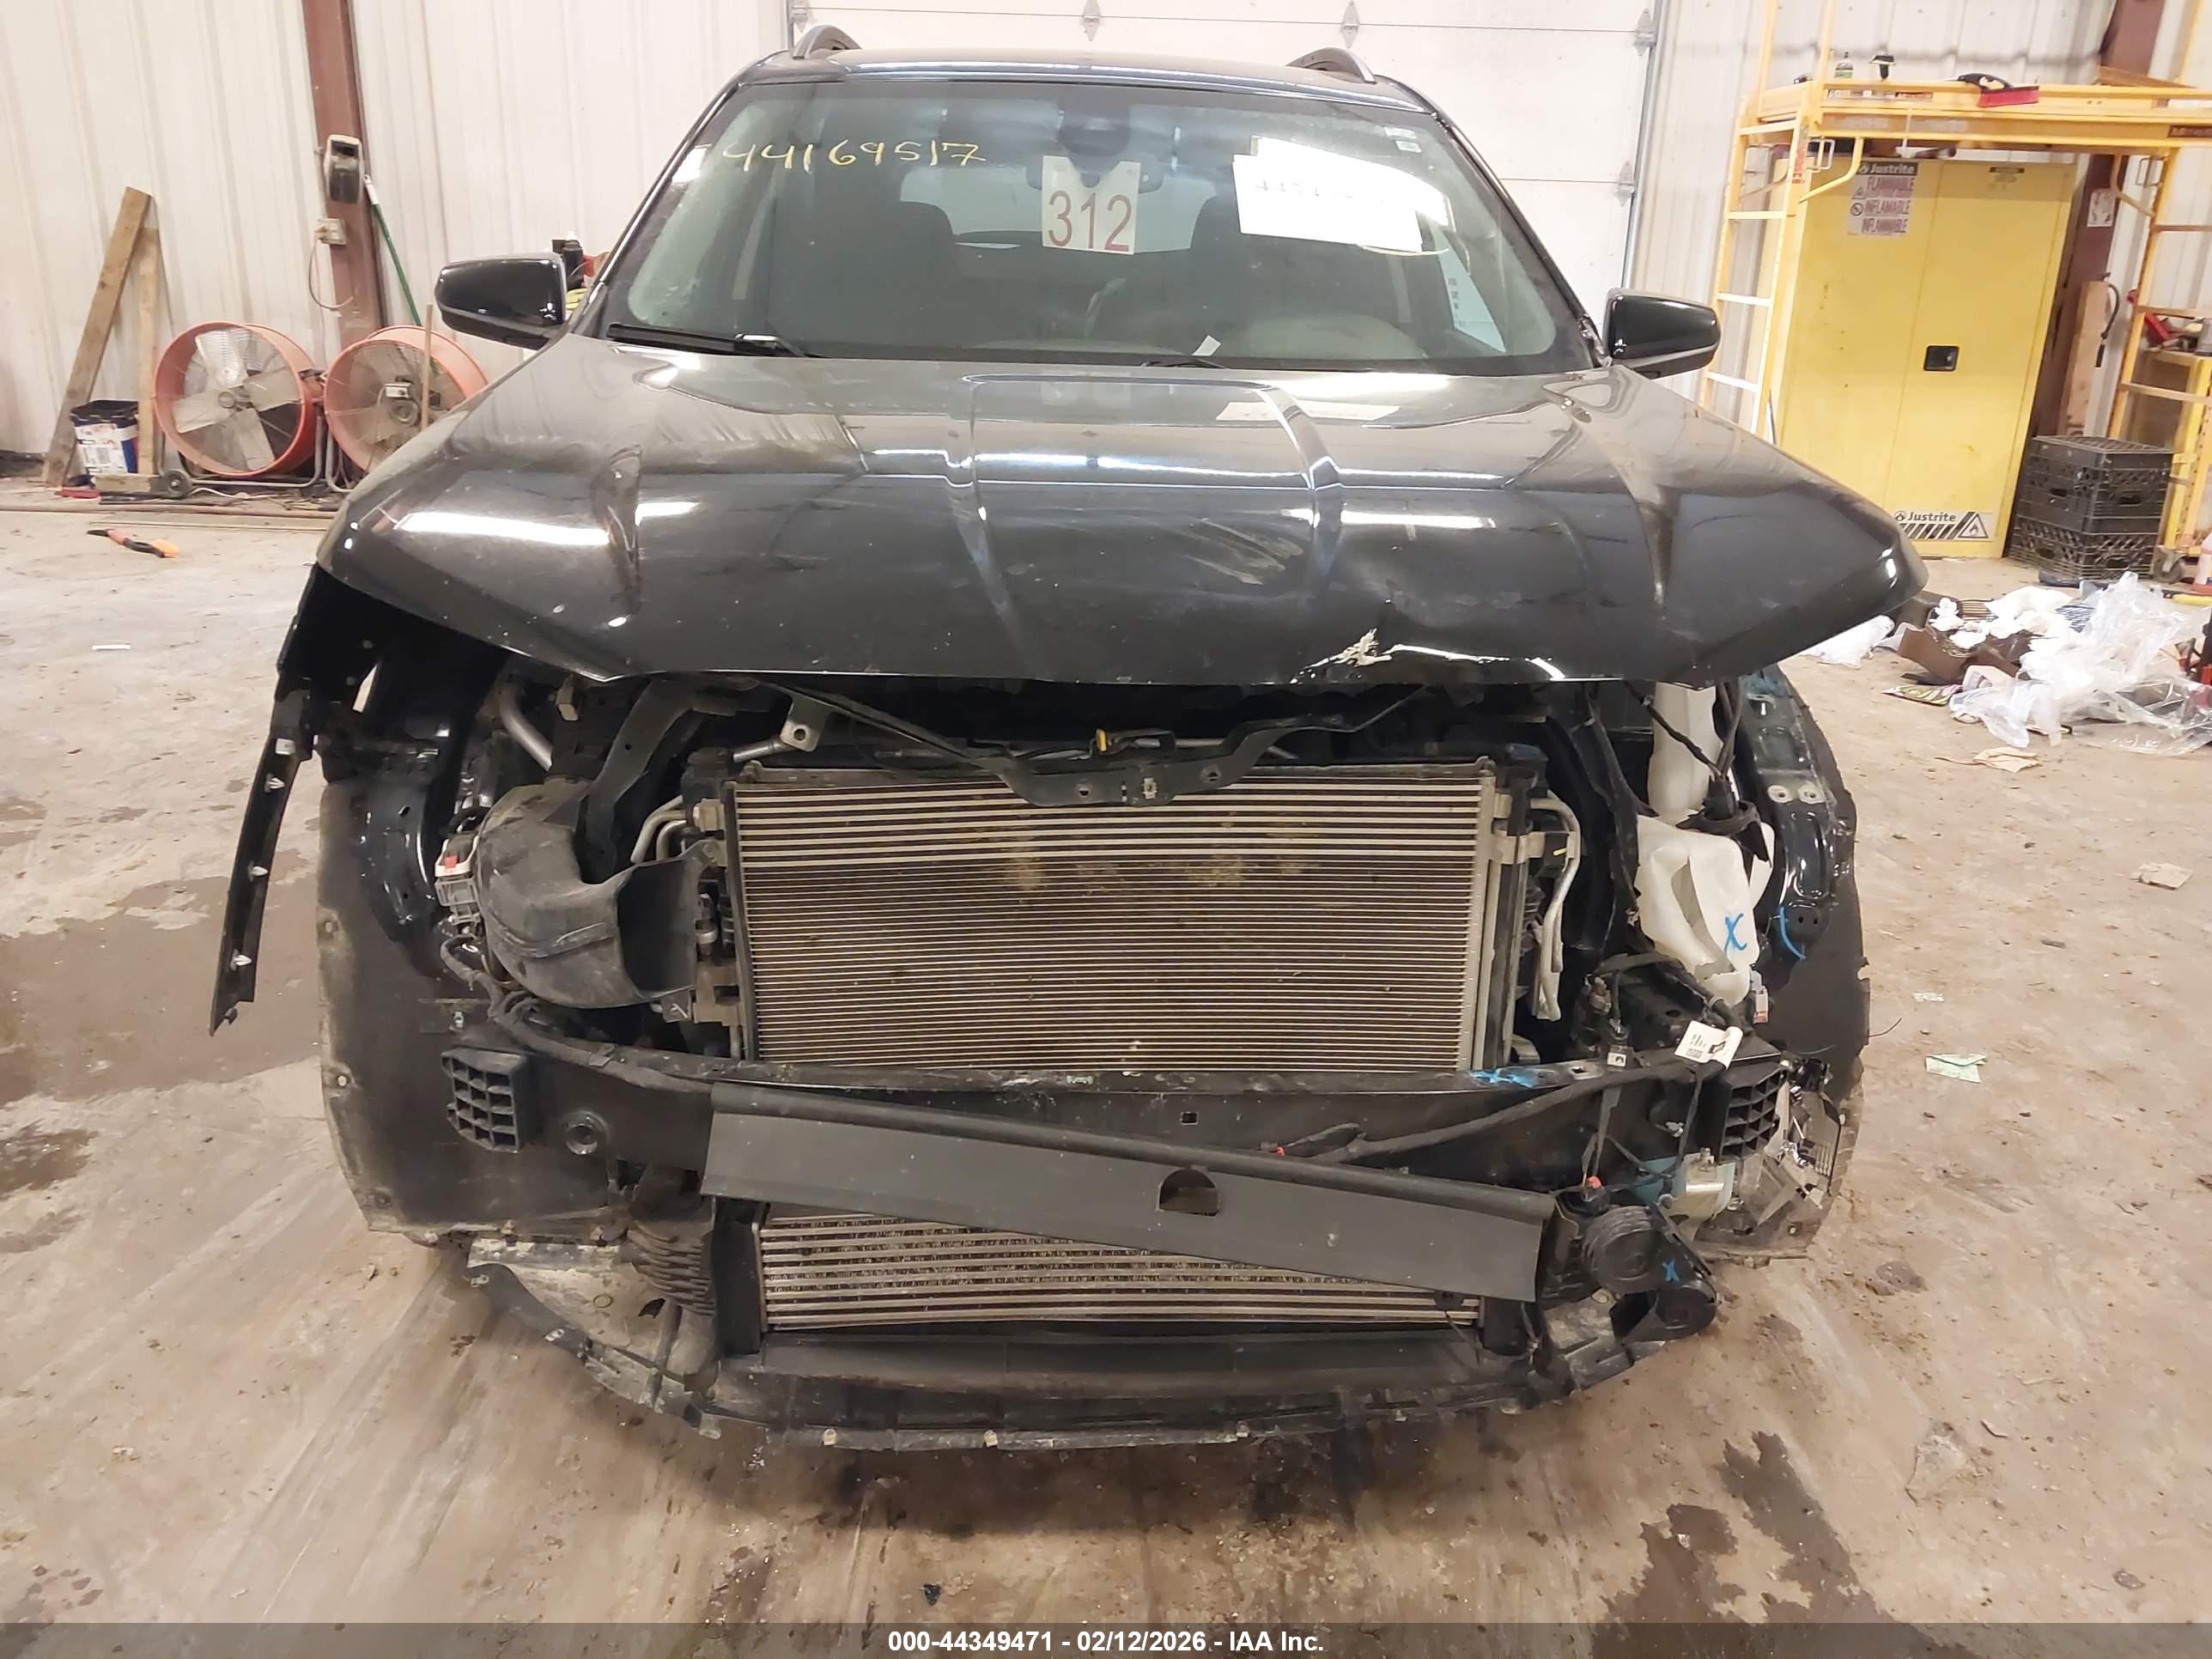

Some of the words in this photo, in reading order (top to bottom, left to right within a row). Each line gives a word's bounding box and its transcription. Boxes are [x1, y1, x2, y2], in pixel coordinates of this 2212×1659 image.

[723, 139, 987, 172] 44169517
[1870, 163, 1916, 174] Justrite
[1048, 190, 1132, 252] 312
[1907, 512, 1957, 522] Justrite
